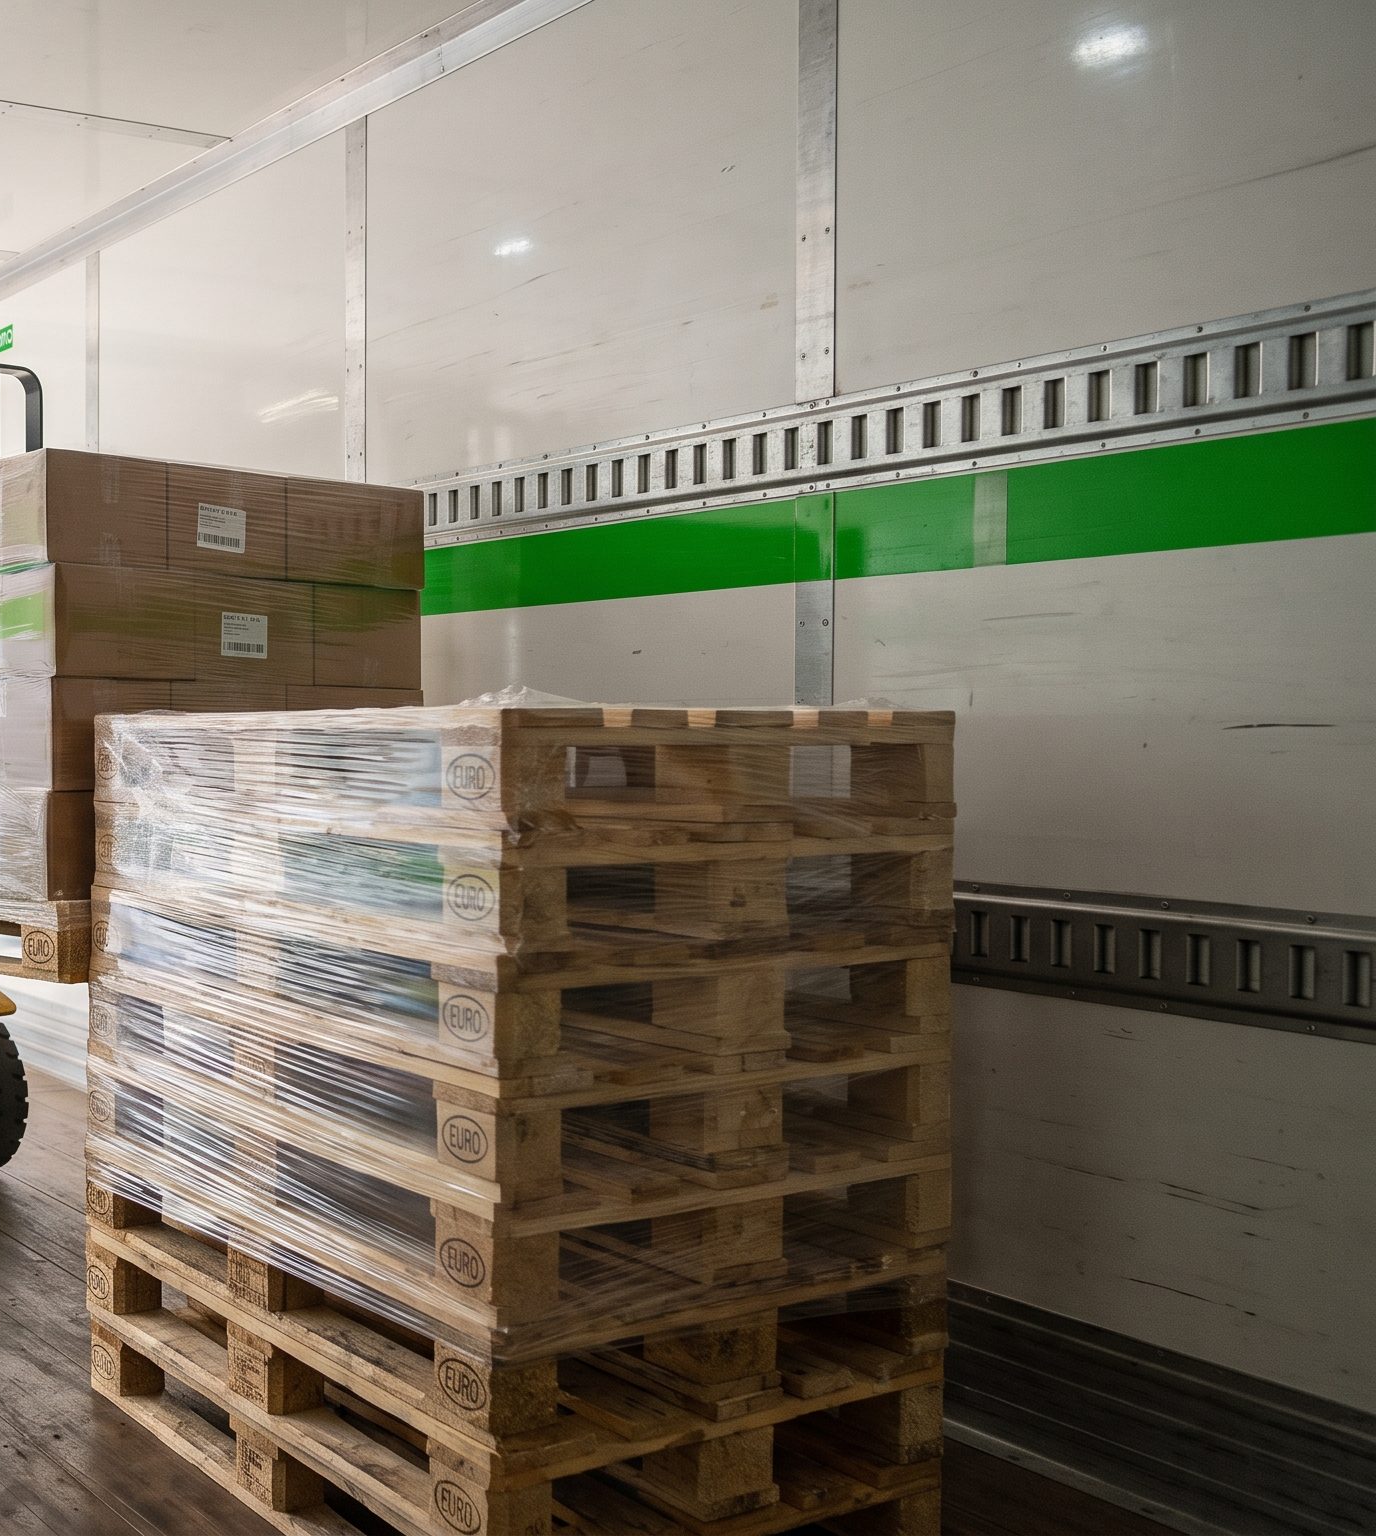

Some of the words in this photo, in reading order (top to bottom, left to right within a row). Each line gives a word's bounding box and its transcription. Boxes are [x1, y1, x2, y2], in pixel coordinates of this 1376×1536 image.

[450, 1004, 481, 1034] EURO
[449, 1123, 481, 1156] EURO
[447, 1245, 479, 1281] EURO
[445, 1365, 479, 1404] EURO
[441, 1487, 473, 1529] EURO
